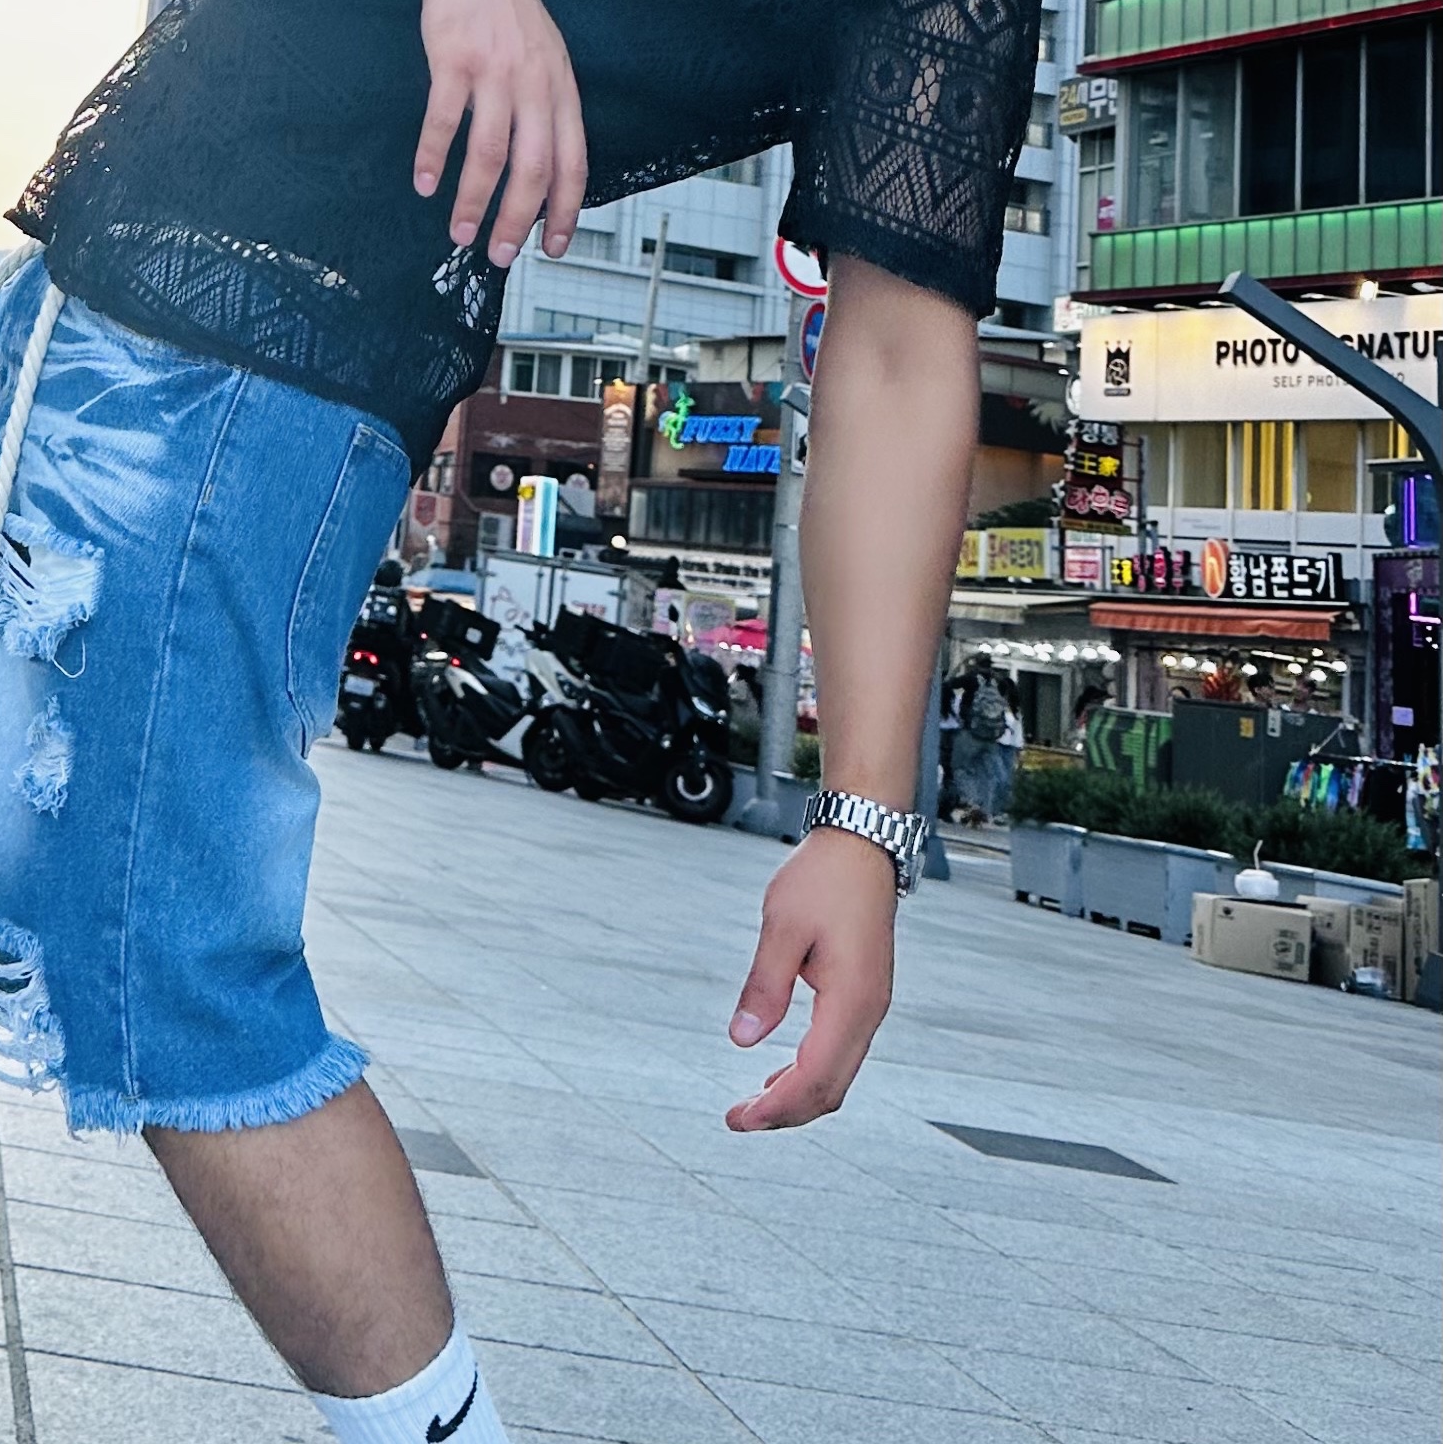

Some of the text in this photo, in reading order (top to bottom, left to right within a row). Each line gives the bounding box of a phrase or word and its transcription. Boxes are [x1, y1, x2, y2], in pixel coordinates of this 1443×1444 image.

[1215, 338, 1300, 367] PHOTO
[1273, 375, 1302, 388] SELF
[679, 415, 763, 443] FUZZY
[1075, 451, 1120, 477] 王家
